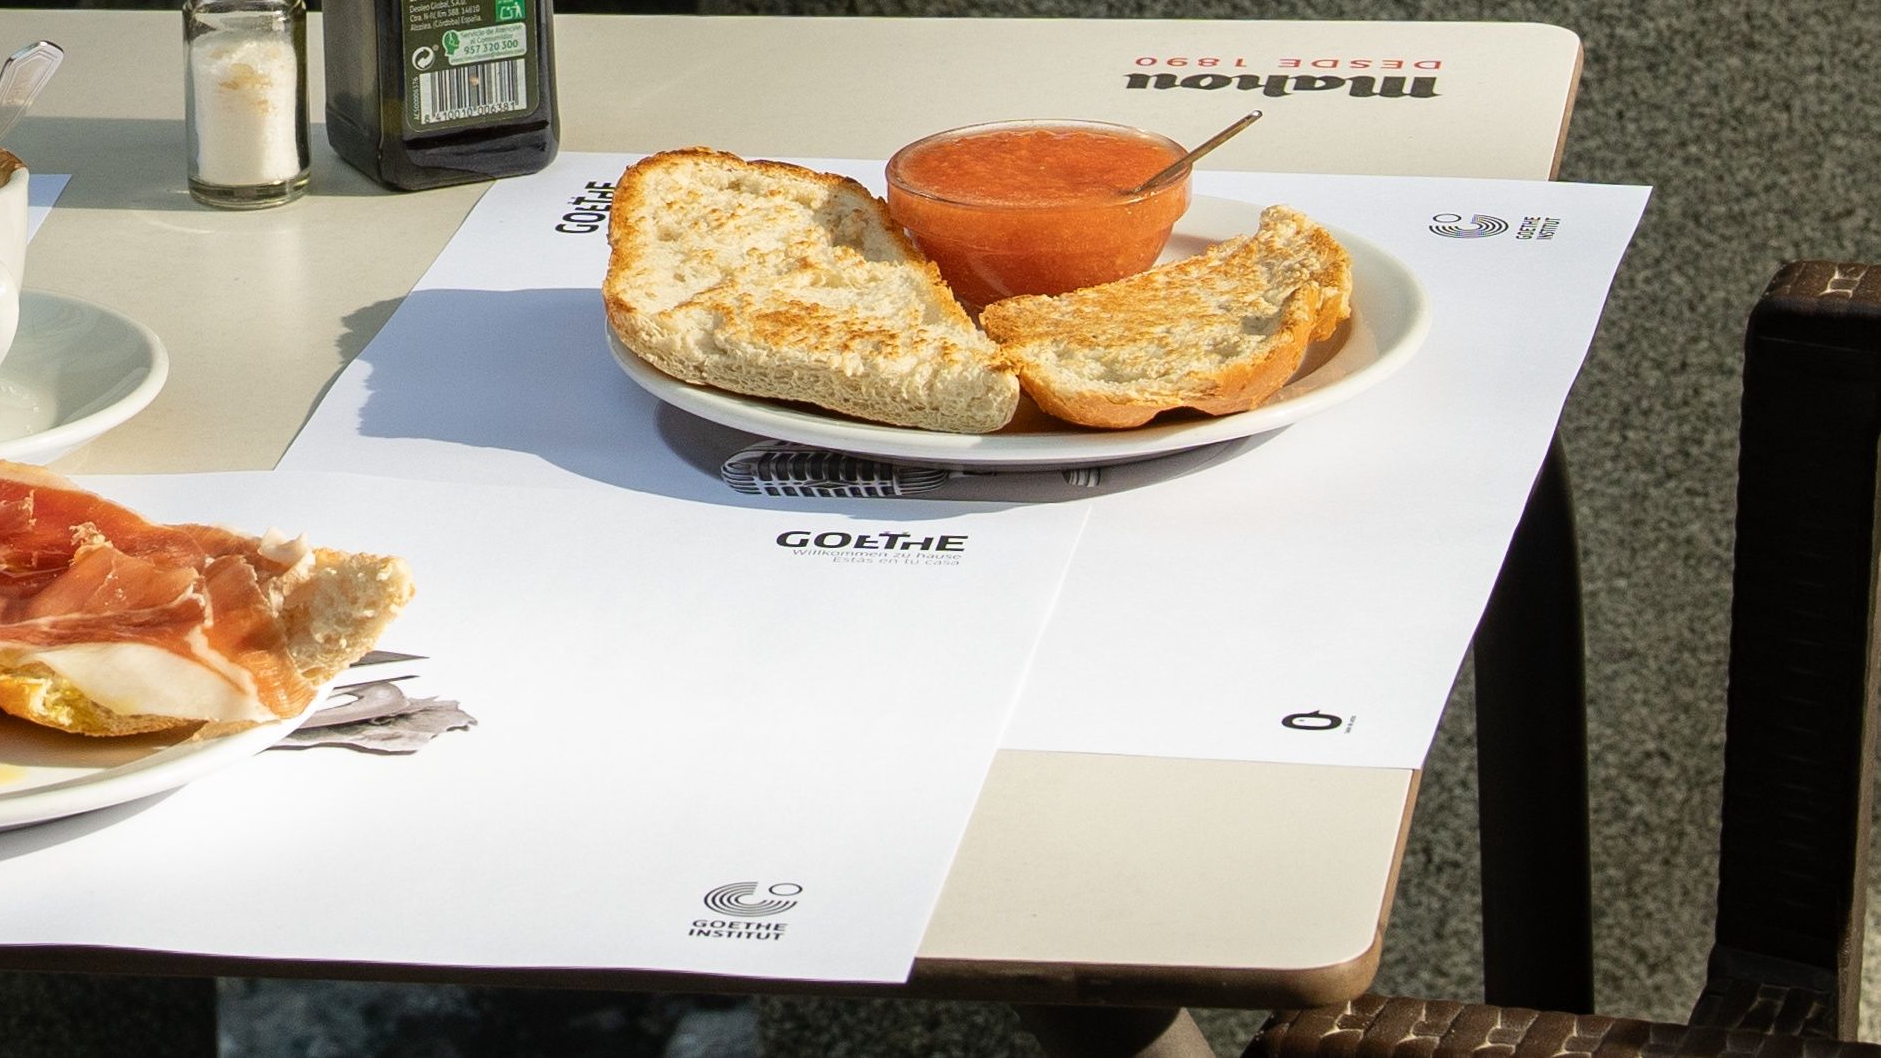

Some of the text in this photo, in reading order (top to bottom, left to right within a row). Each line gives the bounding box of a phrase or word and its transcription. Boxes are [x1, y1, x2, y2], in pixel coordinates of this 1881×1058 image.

[464, 45, 480, 55] 957
[483, 42, 499, 51] 320
[1136, 56, 1442, 70] DESDE 1890
[776, 531, 969, 552] GOETHE
[793, 548, 888, 558] Willkommen
[692, 919, 789, 932] GOETHE
[688, 928, 785, 941] INSTITUT
